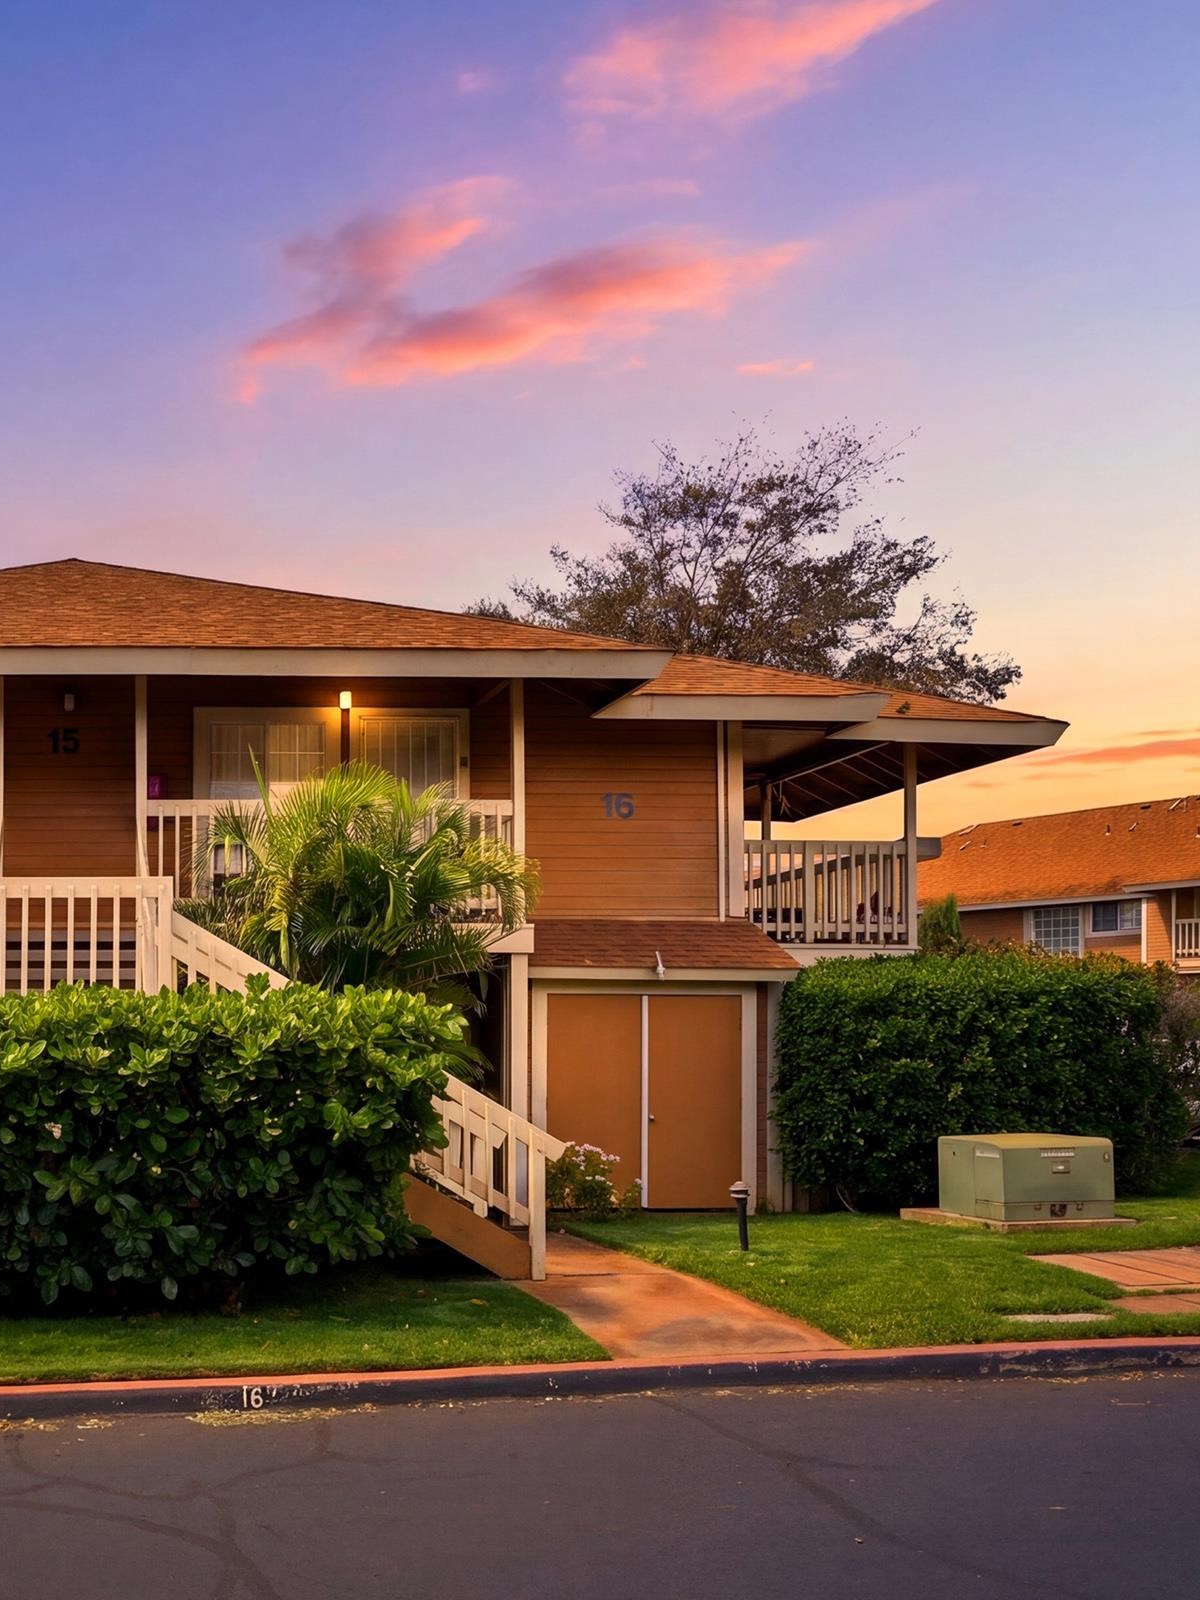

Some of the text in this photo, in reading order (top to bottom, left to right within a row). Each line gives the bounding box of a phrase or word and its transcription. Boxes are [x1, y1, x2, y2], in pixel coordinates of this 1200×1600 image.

[48, 728, 80, 754] 15
[601, 792, 635, 819] 16
[242, 1385, 264, 1408] 16
